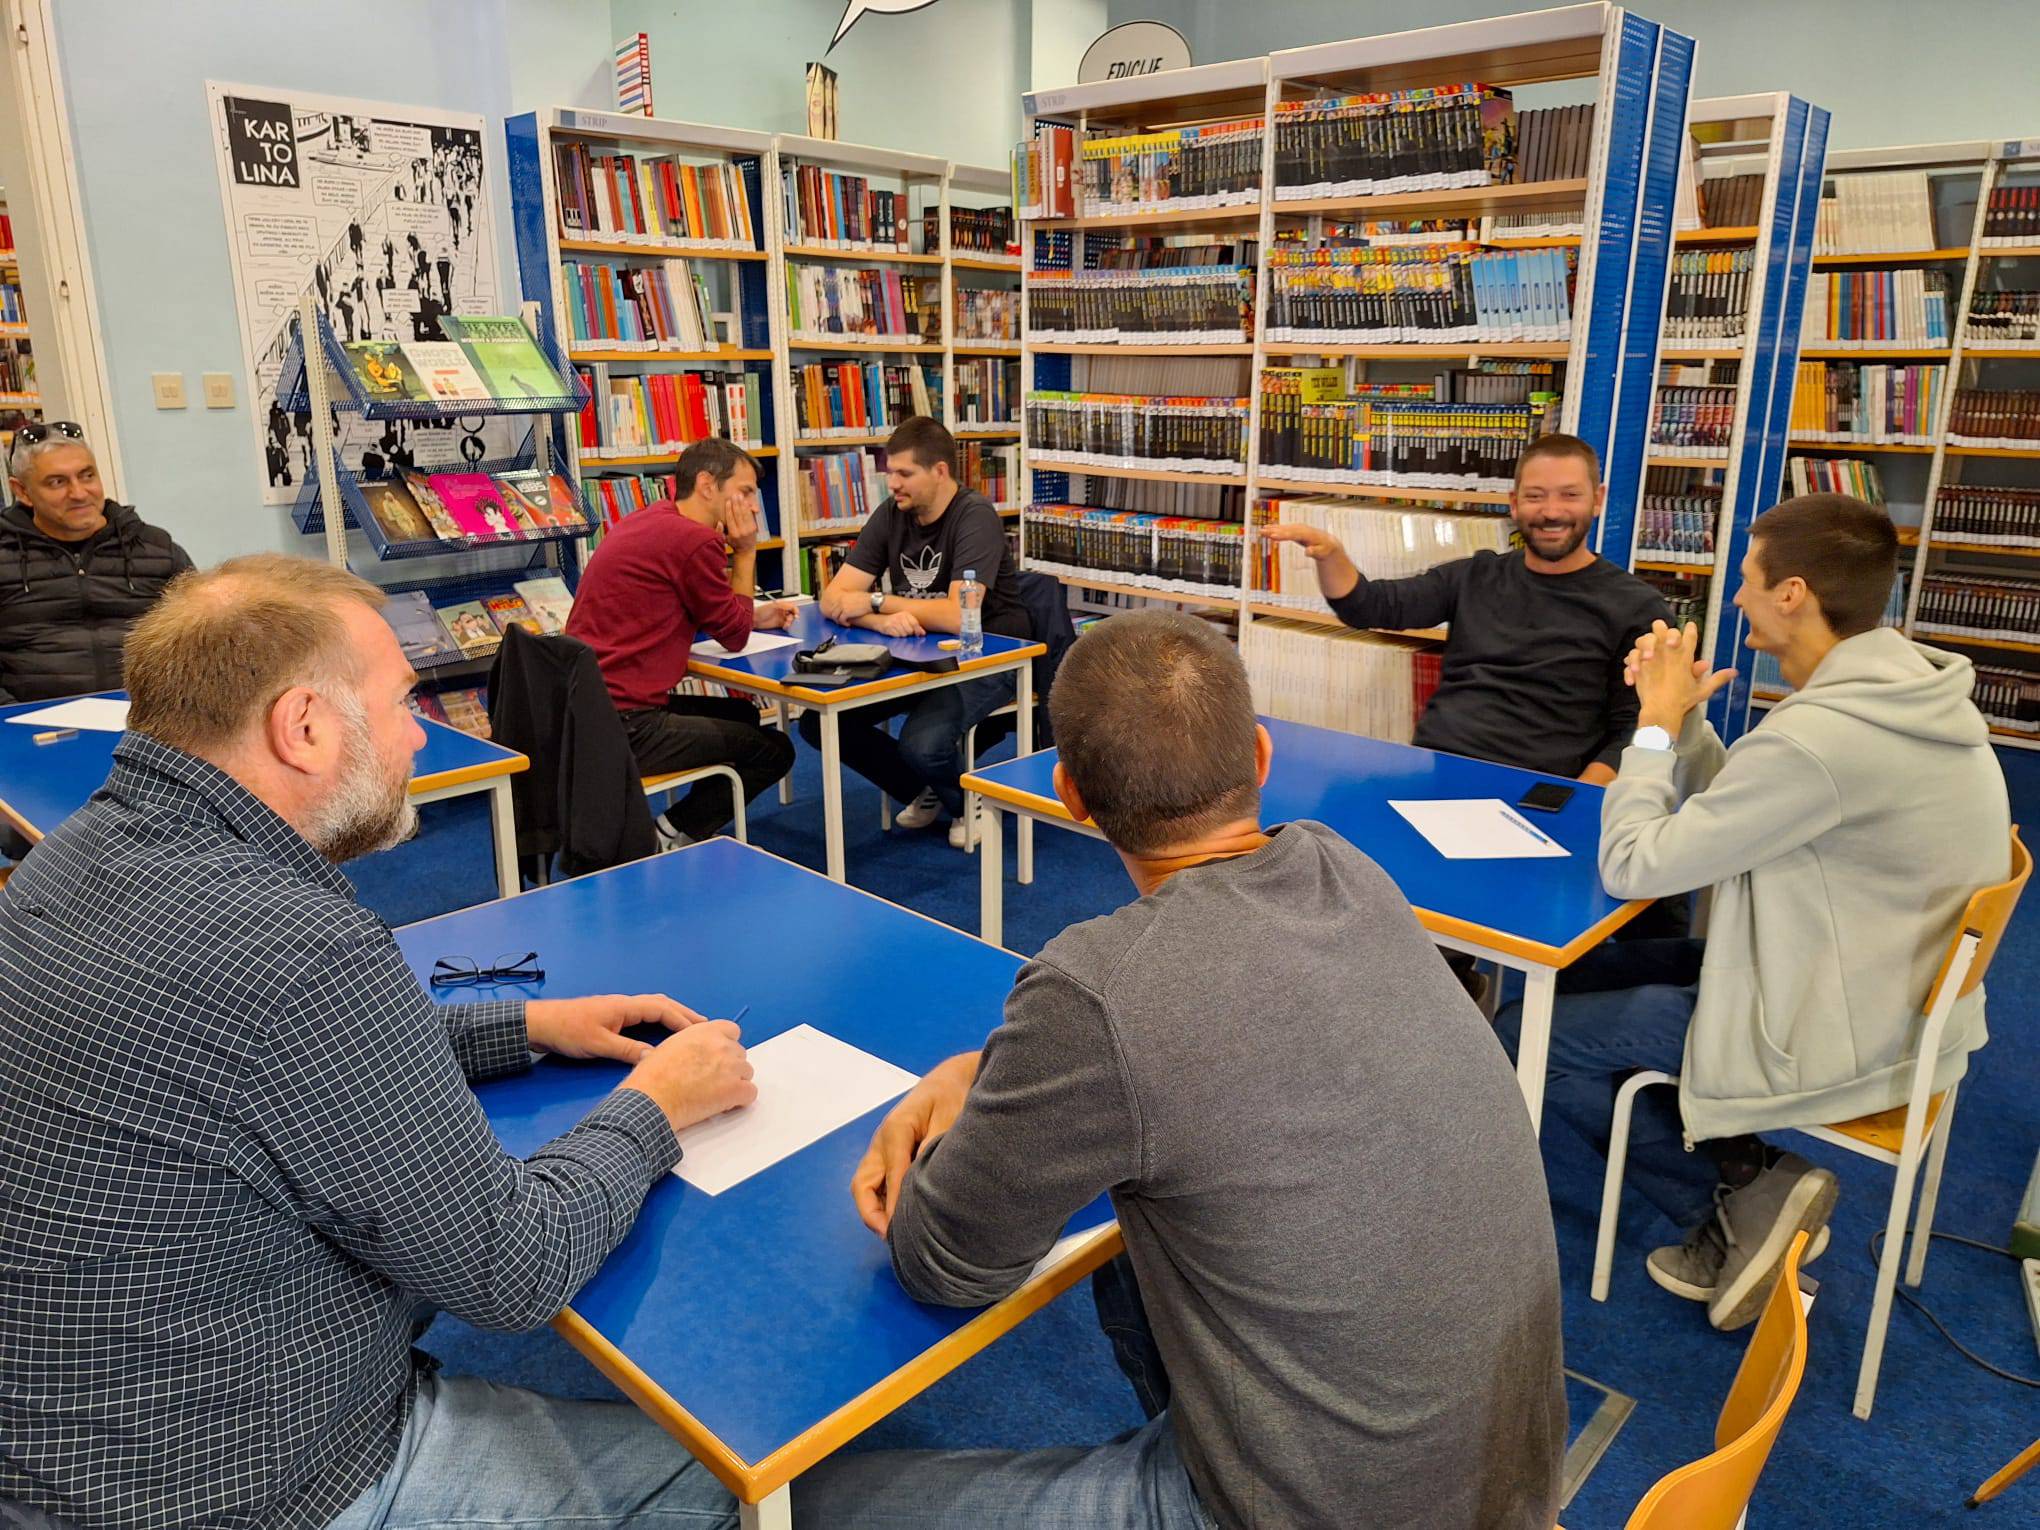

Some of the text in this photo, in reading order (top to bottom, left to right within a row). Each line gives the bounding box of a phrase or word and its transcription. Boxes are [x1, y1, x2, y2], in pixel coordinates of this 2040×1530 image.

[244, 118, 290, 142] KAR
[581, 115, 608, 128] STRIP
[259, 142, 293, 164] TO
[240, 164, 296, 186] LINA
